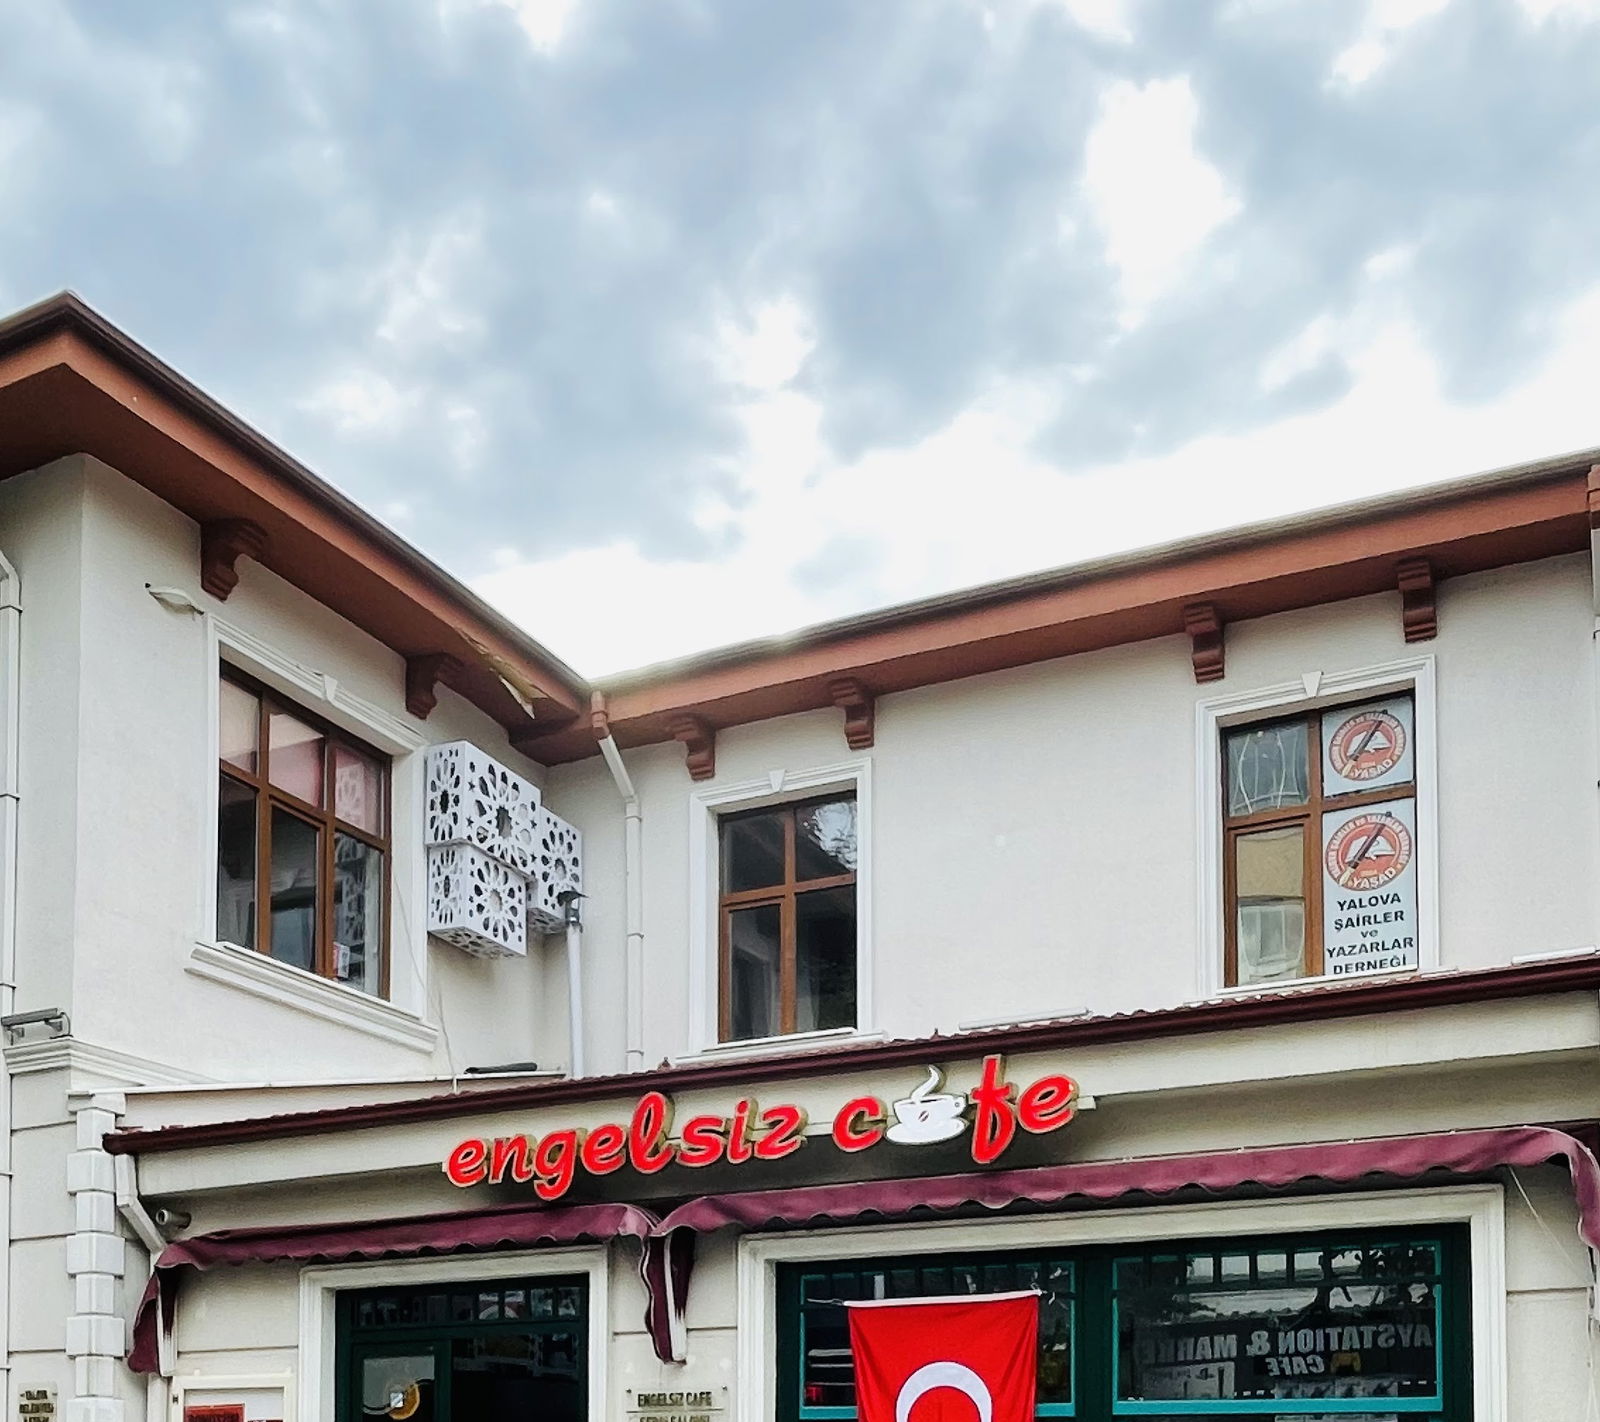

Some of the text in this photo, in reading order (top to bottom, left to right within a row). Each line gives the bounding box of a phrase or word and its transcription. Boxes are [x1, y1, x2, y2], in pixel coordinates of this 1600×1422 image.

[1337, 893, 1402, 911] YALOVA
[1334, 910, 1405, 932] ŞAİRLER
[1360, 929, 1379, 938] ve
[1326, 937, 1414, 958] YAZARLAR
[1333, 954, 1407, 975] DERNEĞİ
[445, 1055, 1076, 1200] engelsiz cfe
